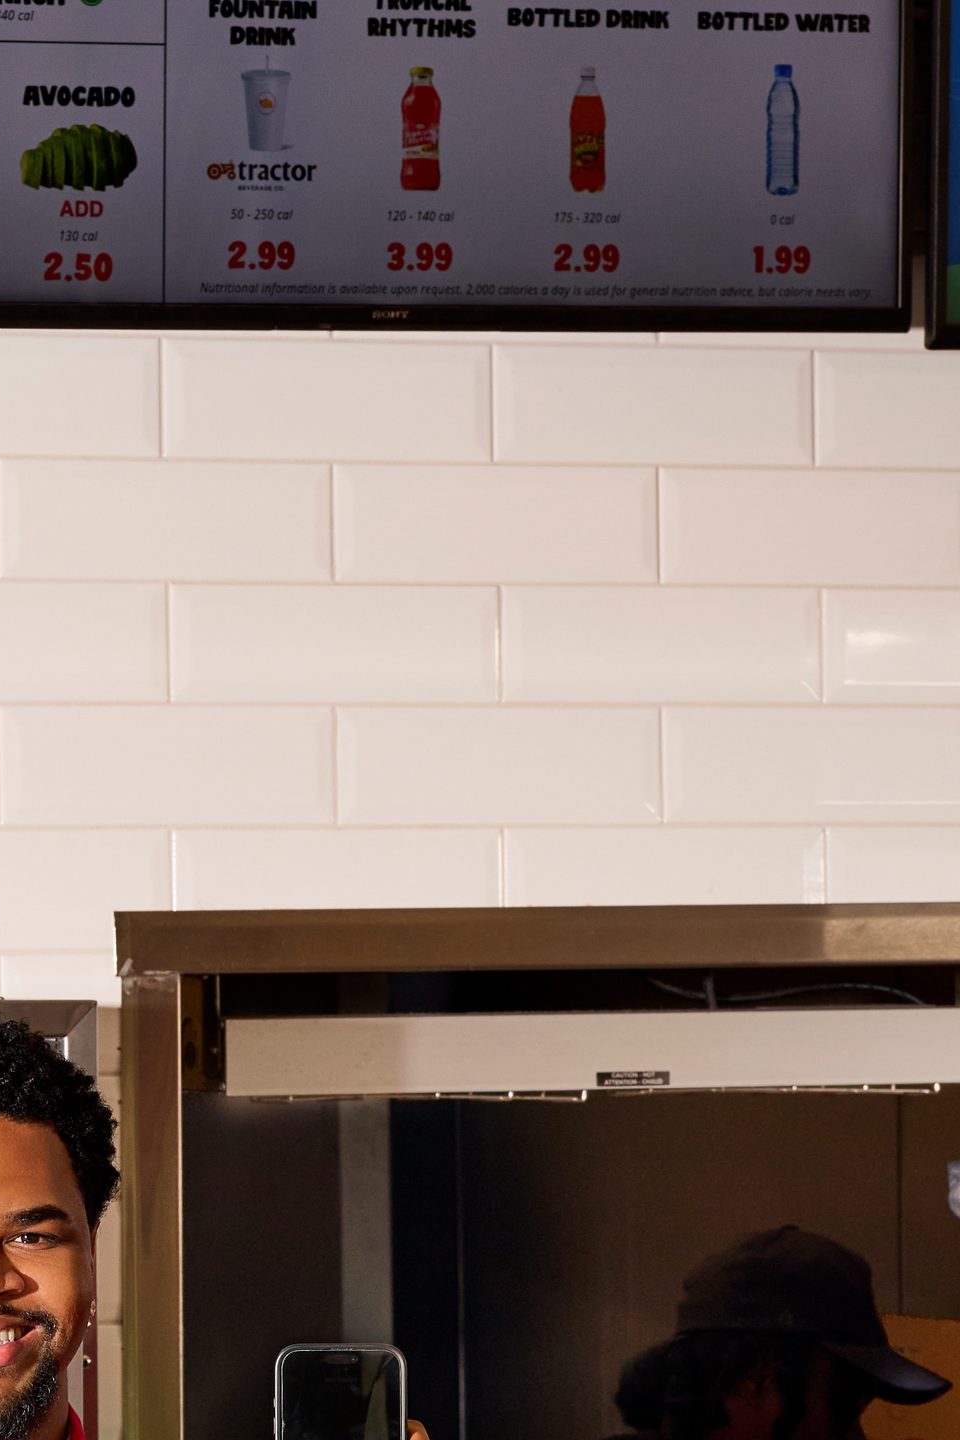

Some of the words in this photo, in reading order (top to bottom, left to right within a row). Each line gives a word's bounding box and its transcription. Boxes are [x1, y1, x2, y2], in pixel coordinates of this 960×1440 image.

[18, 10, 35, 21] cal
[208, 0, 317, 19] FOUNTAIN
[506, 8, 601, 28] BOTTLED
[605, 10, 670, 29] DRINK
[367, 17, 477, 38] RHYTHMS
[697, 12, 790, 31] BOTTLED
[795, 13, 871, 33] WATER
[230, 26, 296, 46] DRINK
[23, 85, 136, 107] AVOCADO
[238, 161, 317, 182] tractor
[60, 200, 103, 218] ADD
[230, 208, 245, 220] 50
[254, 208, 274, 220] 250
[276, 208, 294, 220] cal
[387, 210, 406, 223] 120
[416, 210, 436, 223] 140
[438, 210, 455, 223] cal
[554, 211, 572, 223] 175
[583, 212, 602, 224] 320
[605, 212, 621, 224] cal
[779, 215, 794, 226] cal
[60, 230, 79, 242] 130
[82, 230, 98, 242] cal
[228, 241, 295, 270] 2.99
[387, 242, 453, 271] 3.99
[554, 244, 620, 272] 2.99
[752, 245, 811, 274] 1.99
[43, 252, 113, 282] 2.50
[200, 282, 258, 294] Nutritional
[262, 283, 325, 296] information
[328, 284, 336, 294] is
[340, 284, 387, 295] available
[392, 286, 417, 297] upon
[466, 284, 495, 297] 2,000
[498, 284, 538, 296] calories
[551, 285, 570, 298] day
[572, 285, 581, 296] is
[584, 285, 609, 296] used
[611, 286, 626, 298] for
[630, 286, 669, 298] general
[672, 286, 716, 297] nutrition
[758, 286, 774, 297] but
[778, 287, 812, 298] calorie
[815, 287, 845, 298] needs
[371, 310, 409, 319] SONY
